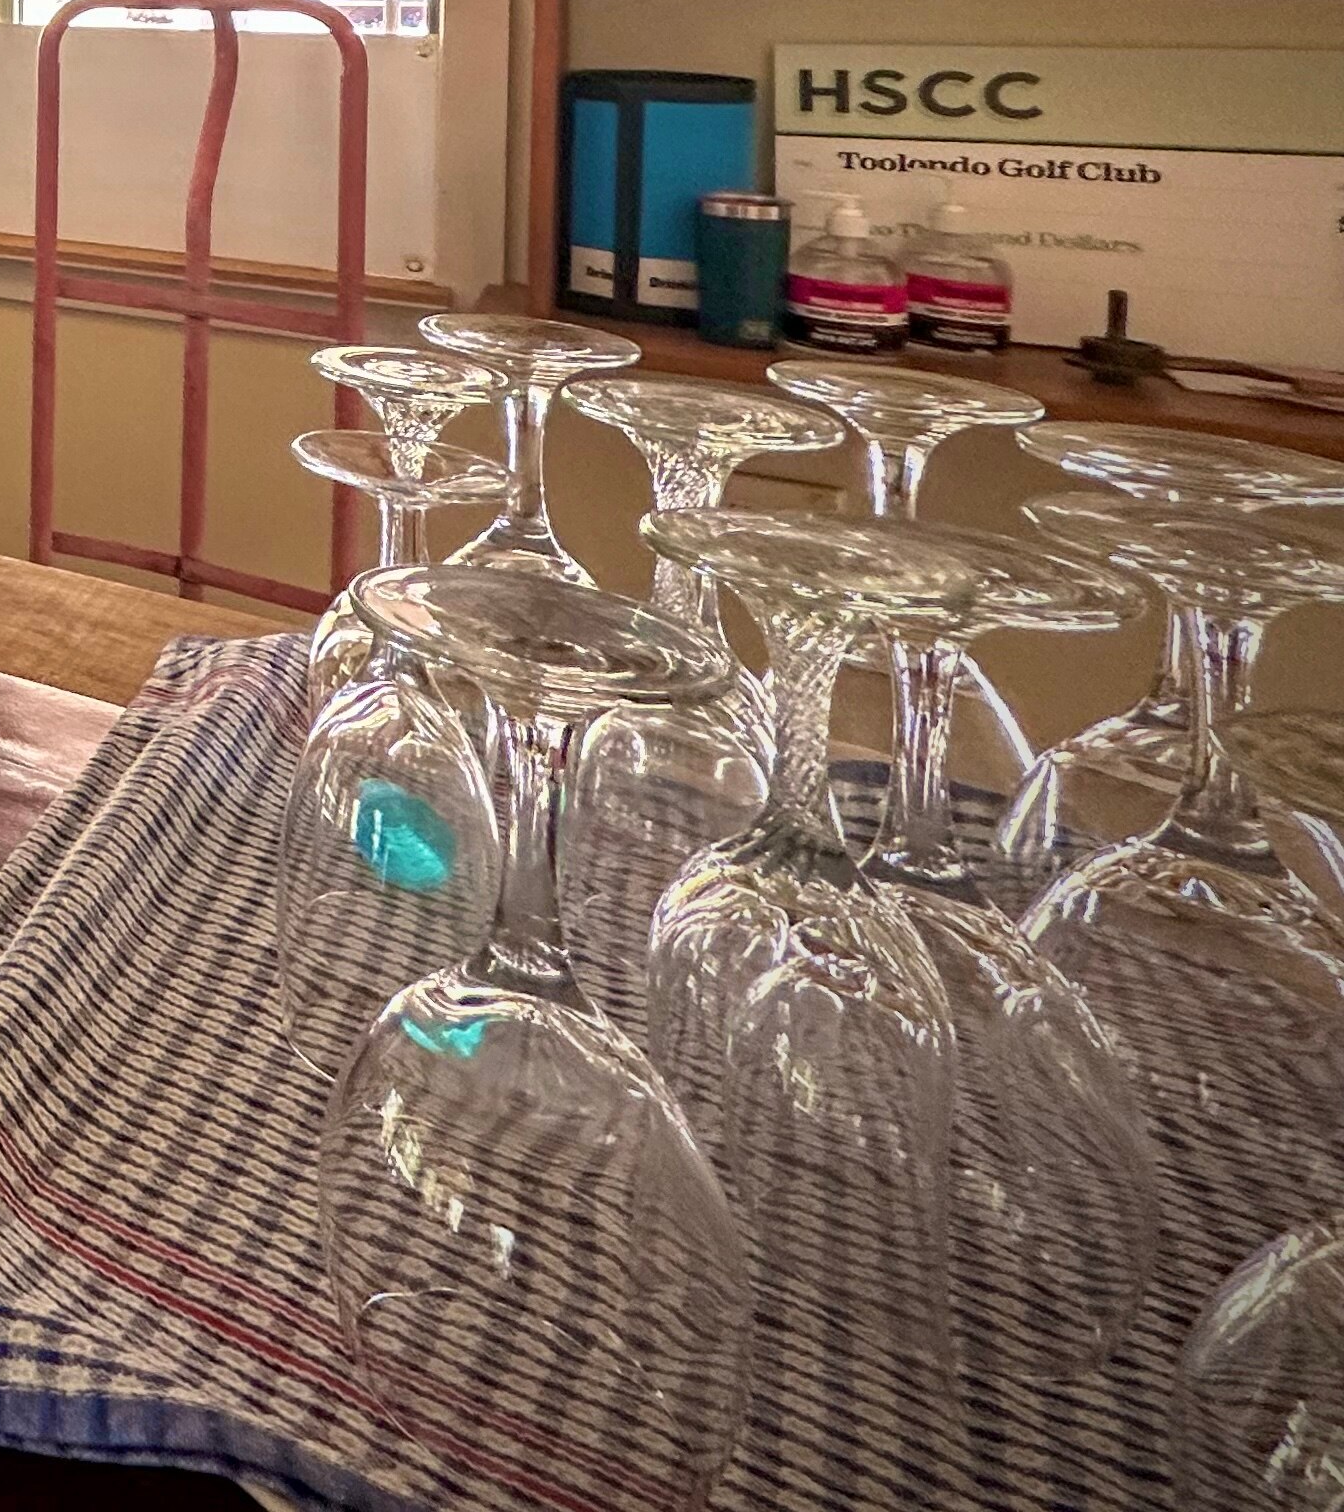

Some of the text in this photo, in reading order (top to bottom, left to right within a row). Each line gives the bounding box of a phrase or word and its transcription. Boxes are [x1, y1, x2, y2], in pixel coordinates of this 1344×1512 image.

[798, 68, 1044, 120] HSCC
[998, 158, 1072, 180] Golf
[1076, 161, 1162, 184] Club
